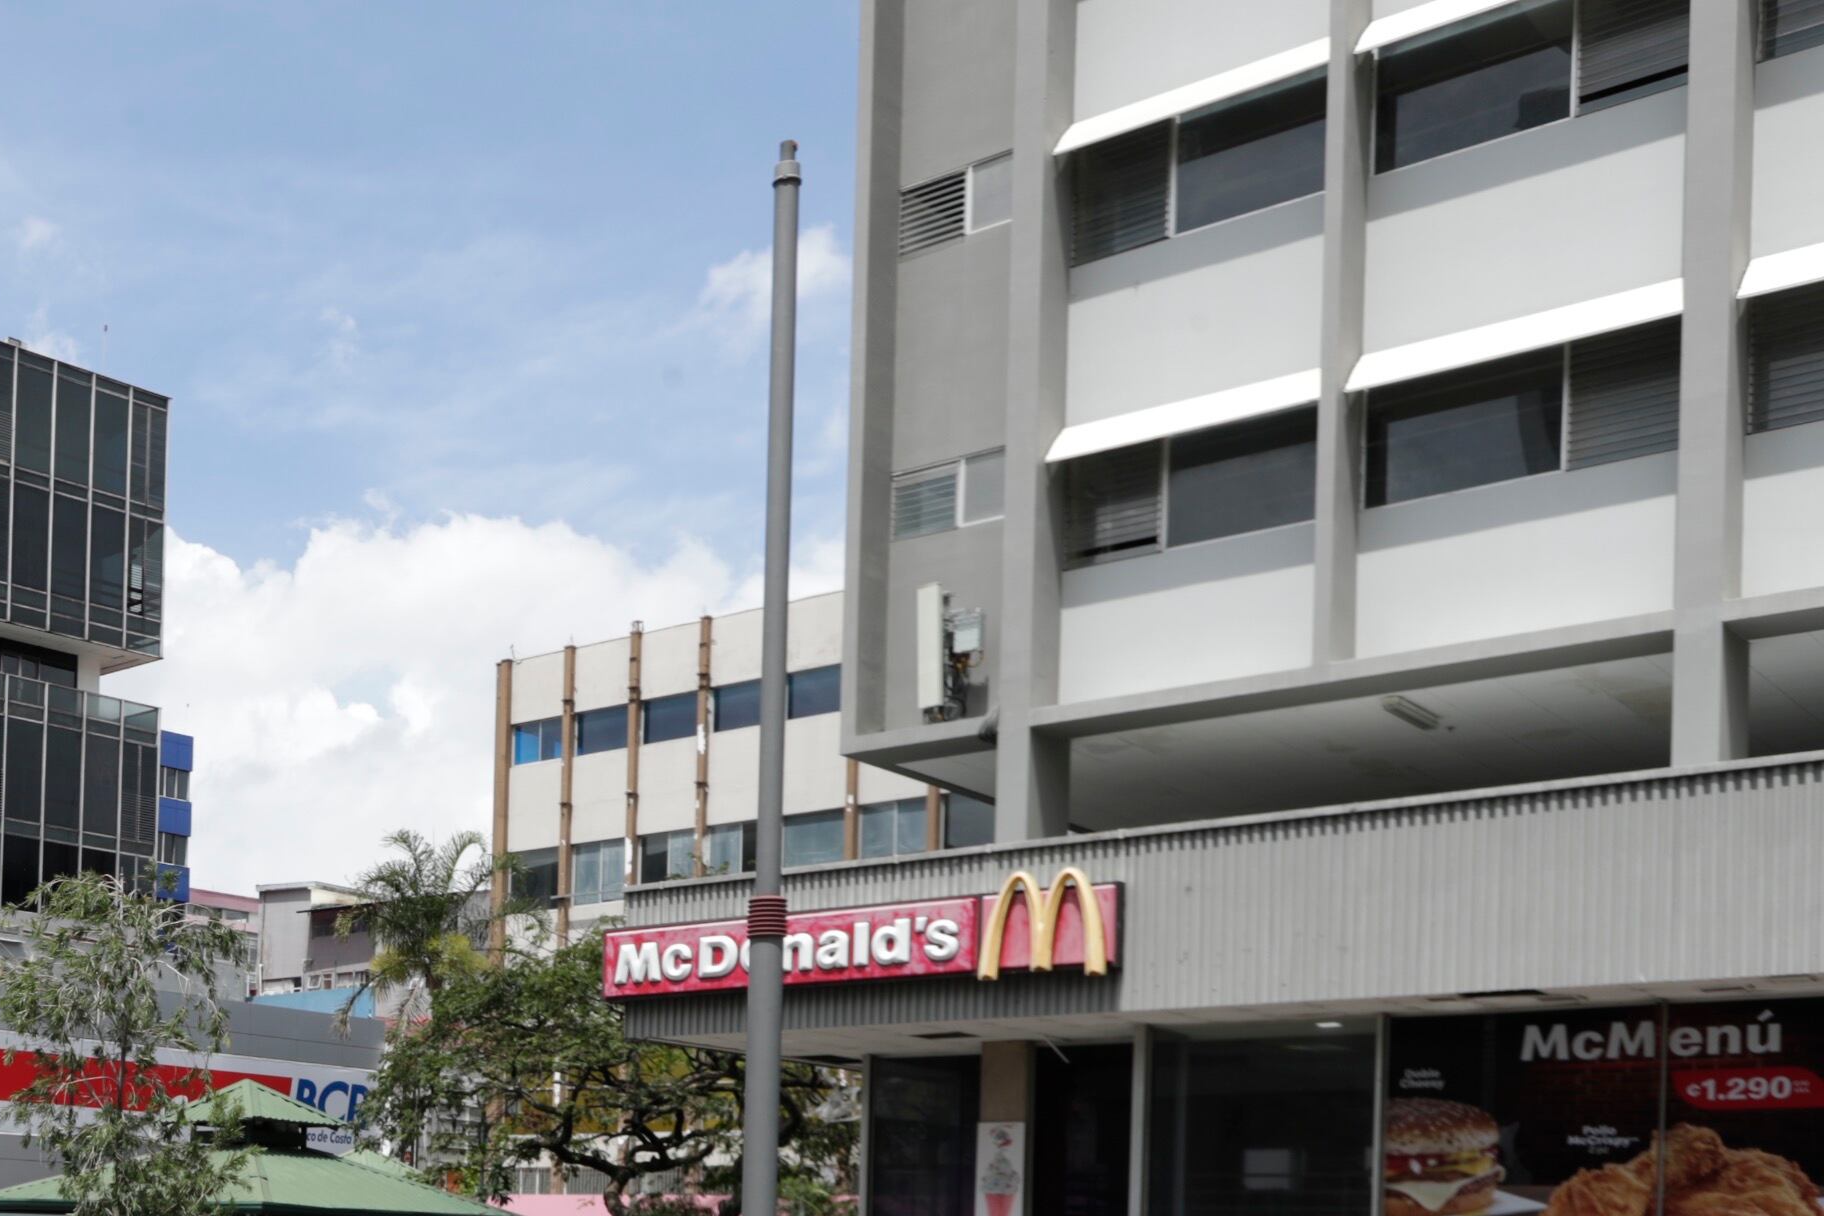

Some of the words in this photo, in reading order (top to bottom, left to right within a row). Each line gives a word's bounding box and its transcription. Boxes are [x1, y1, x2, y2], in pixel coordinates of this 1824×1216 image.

[614, 915, 961, 986] McDnald's
[1520, 1009, 1783, 1062] McMenú
[317, 1129, 328, 1143] de
[329, 1131, 352, 1144] Costa
